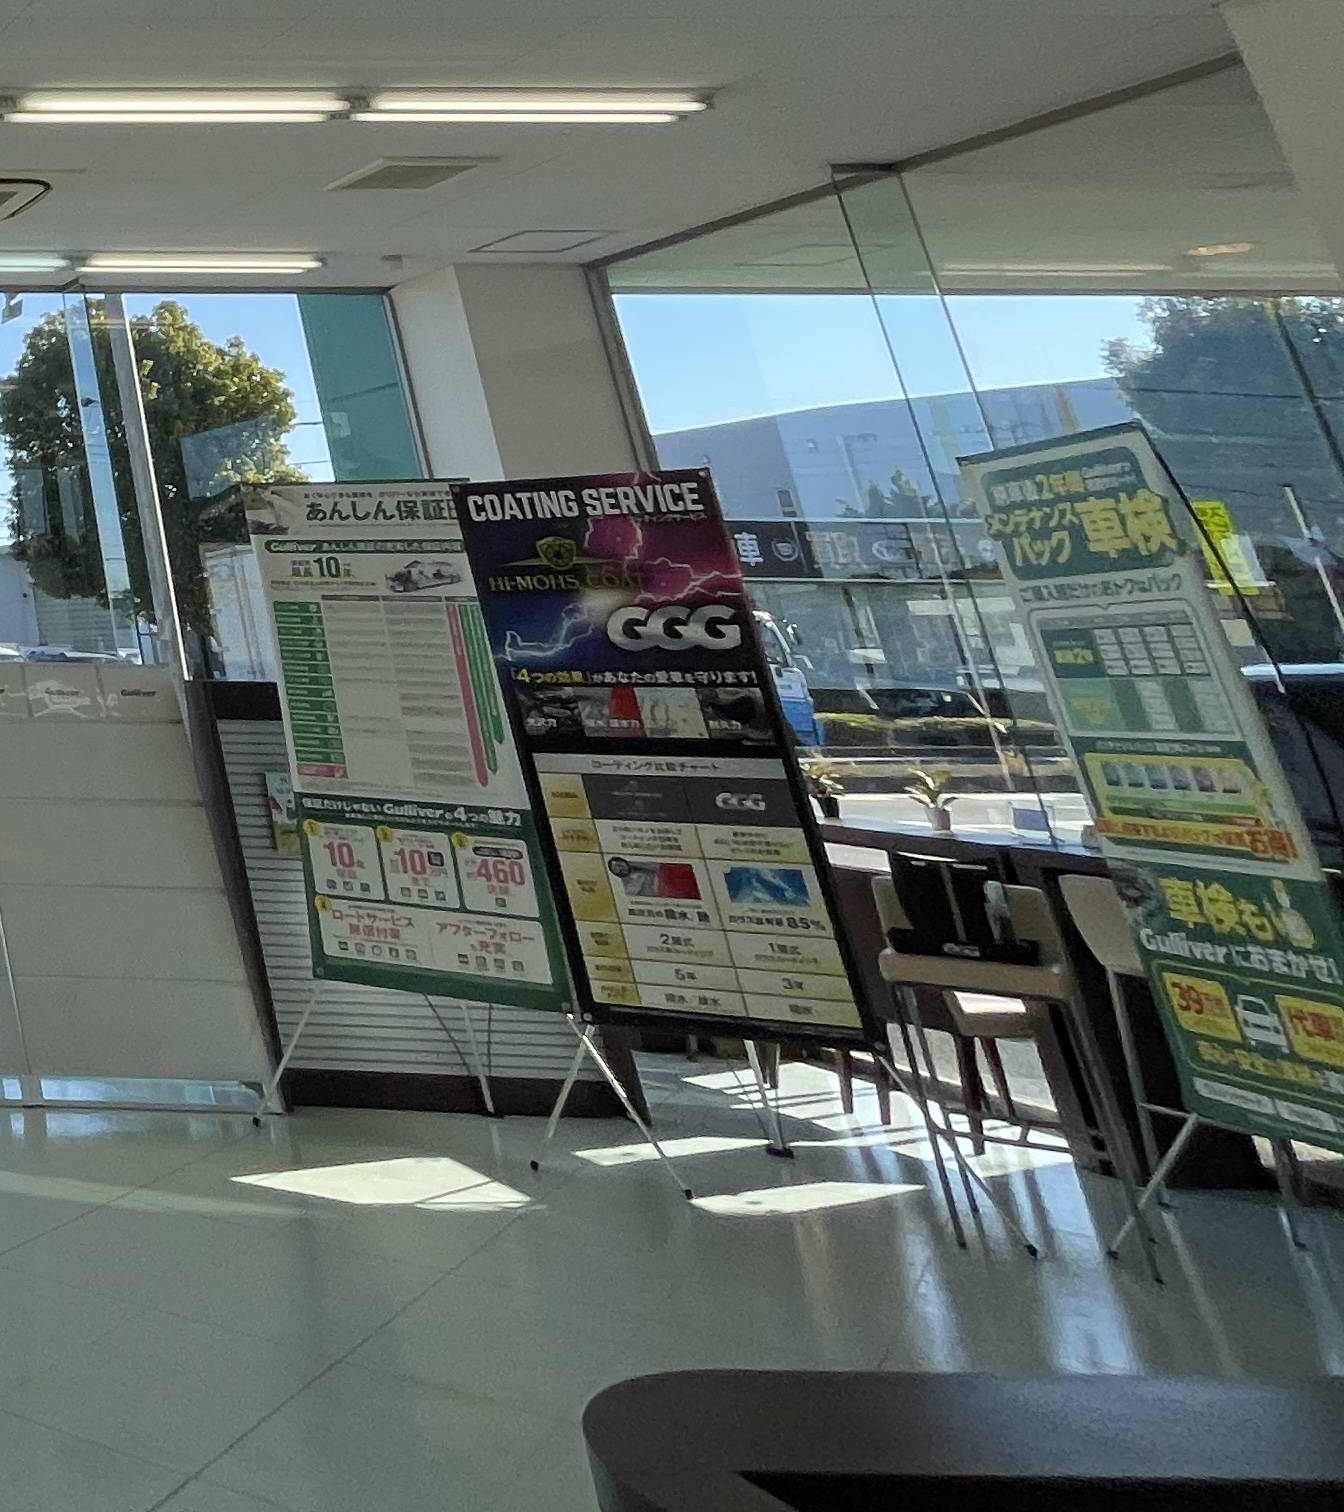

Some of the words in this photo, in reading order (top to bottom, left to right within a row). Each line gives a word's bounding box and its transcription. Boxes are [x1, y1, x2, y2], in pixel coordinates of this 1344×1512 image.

[467, 489, 579, 522] COATING
[582, 482, 705, 516] SERVICE
[1074, 489, 1178, 558] 車検
[606, 604, 742, 651] GGG
